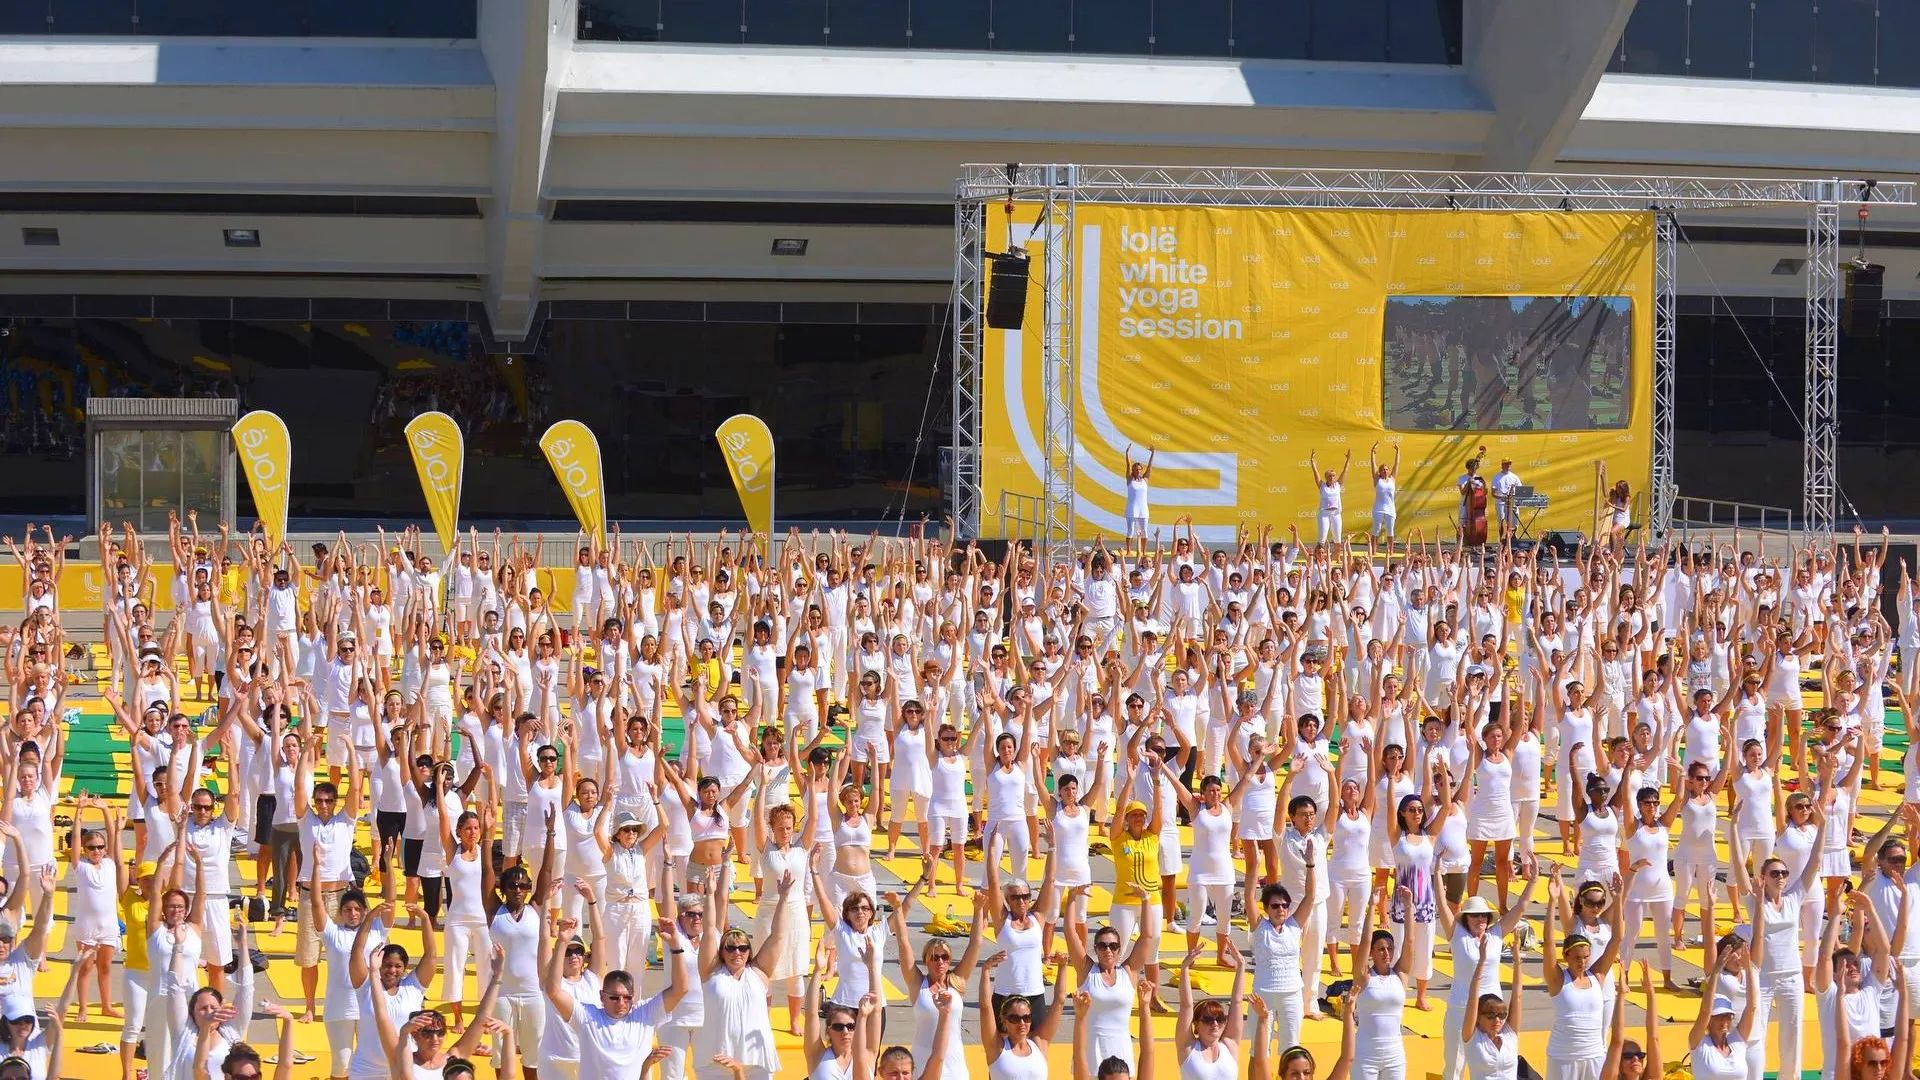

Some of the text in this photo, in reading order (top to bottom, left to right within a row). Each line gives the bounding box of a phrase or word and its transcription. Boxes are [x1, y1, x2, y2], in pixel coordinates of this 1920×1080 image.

[1120, 225, 1178, 253] lolë
[1119, 256, 1208, 284] white
[1118, 287, 1198, 314] yoga
[1118, 313, 1243, 340] session
[507, 357, 513, 365] 2
